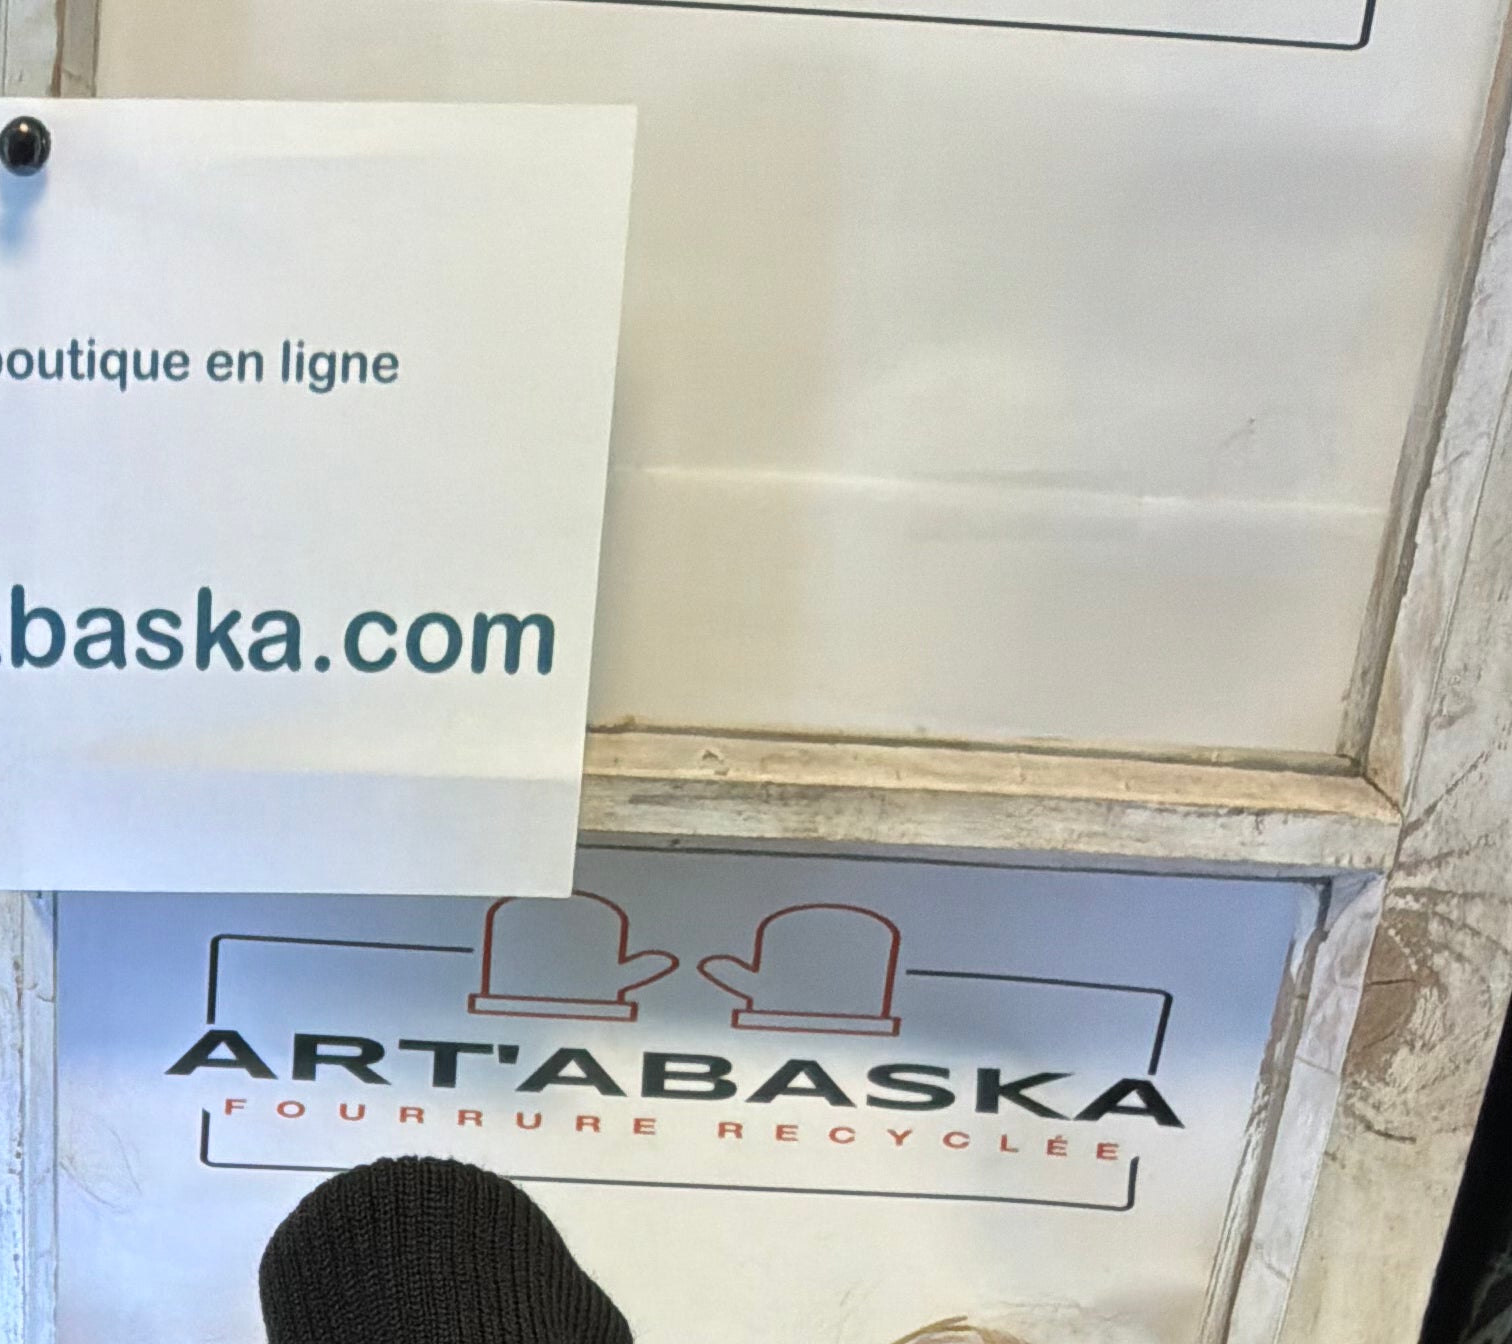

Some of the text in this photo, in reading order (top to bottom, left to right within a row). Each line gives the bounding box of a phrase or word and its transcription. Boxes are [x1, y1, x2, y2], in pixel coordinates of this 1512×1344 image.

[206, 350, 264, 382] en
[281, 340, 400, 394] ligne
[166, 1029, 1185, 1129] ART'ABASKA
[224, 1098, 1119, 1161] FOURRURE RECYCLÉE
